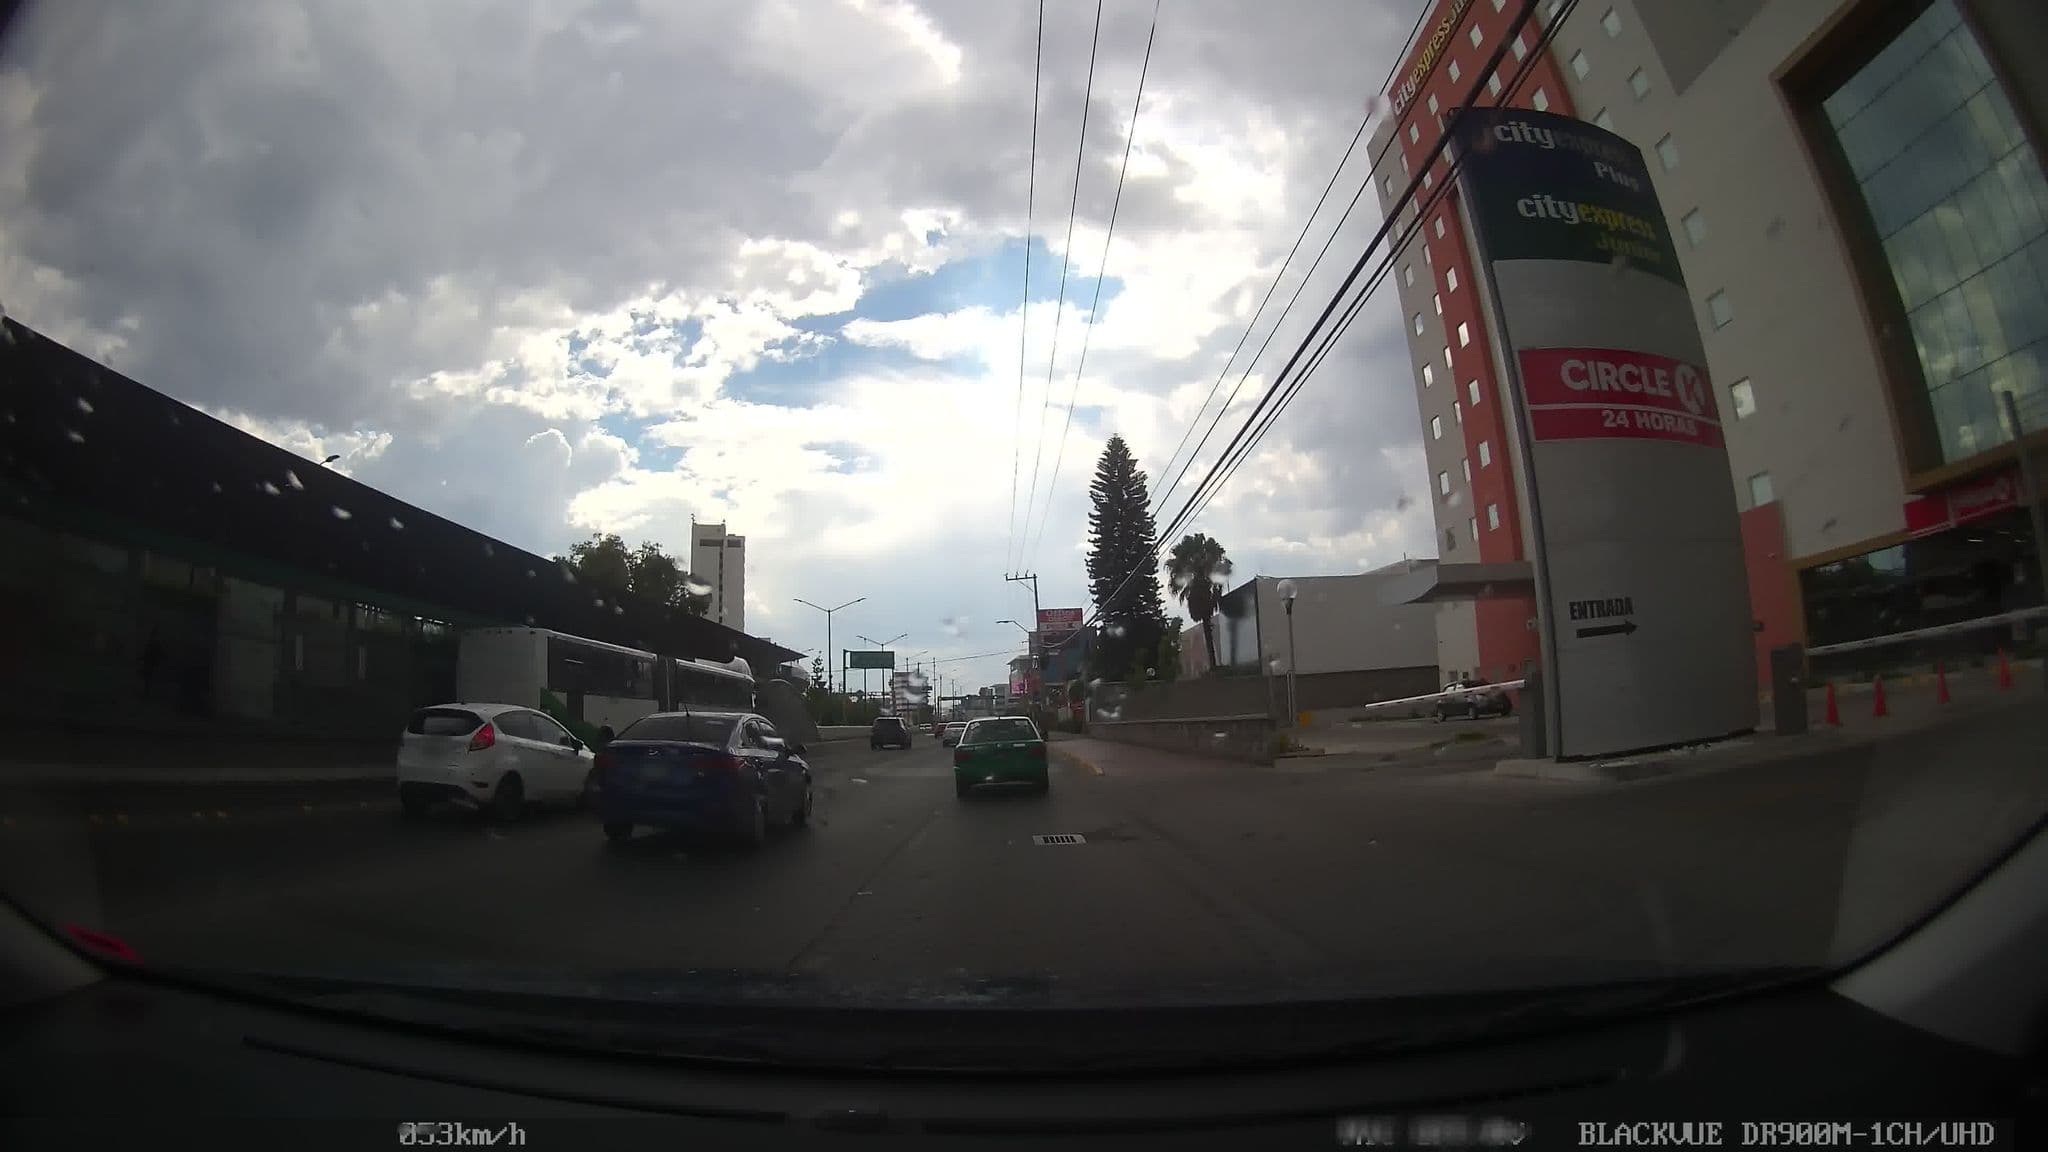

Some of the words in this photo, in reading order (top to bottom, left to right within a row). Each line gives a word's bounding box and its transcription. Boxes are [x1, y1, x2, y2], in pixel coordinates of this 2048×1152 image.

[1594, 162, 1640, 191] Plus
[1561, 359, 1672, 397] CIRCLE
[1602, 410, 1629, 427] 24
[1636, 412, 1697, 436] HORAS
[1569, 597, 1633, 620] ENTRADA
